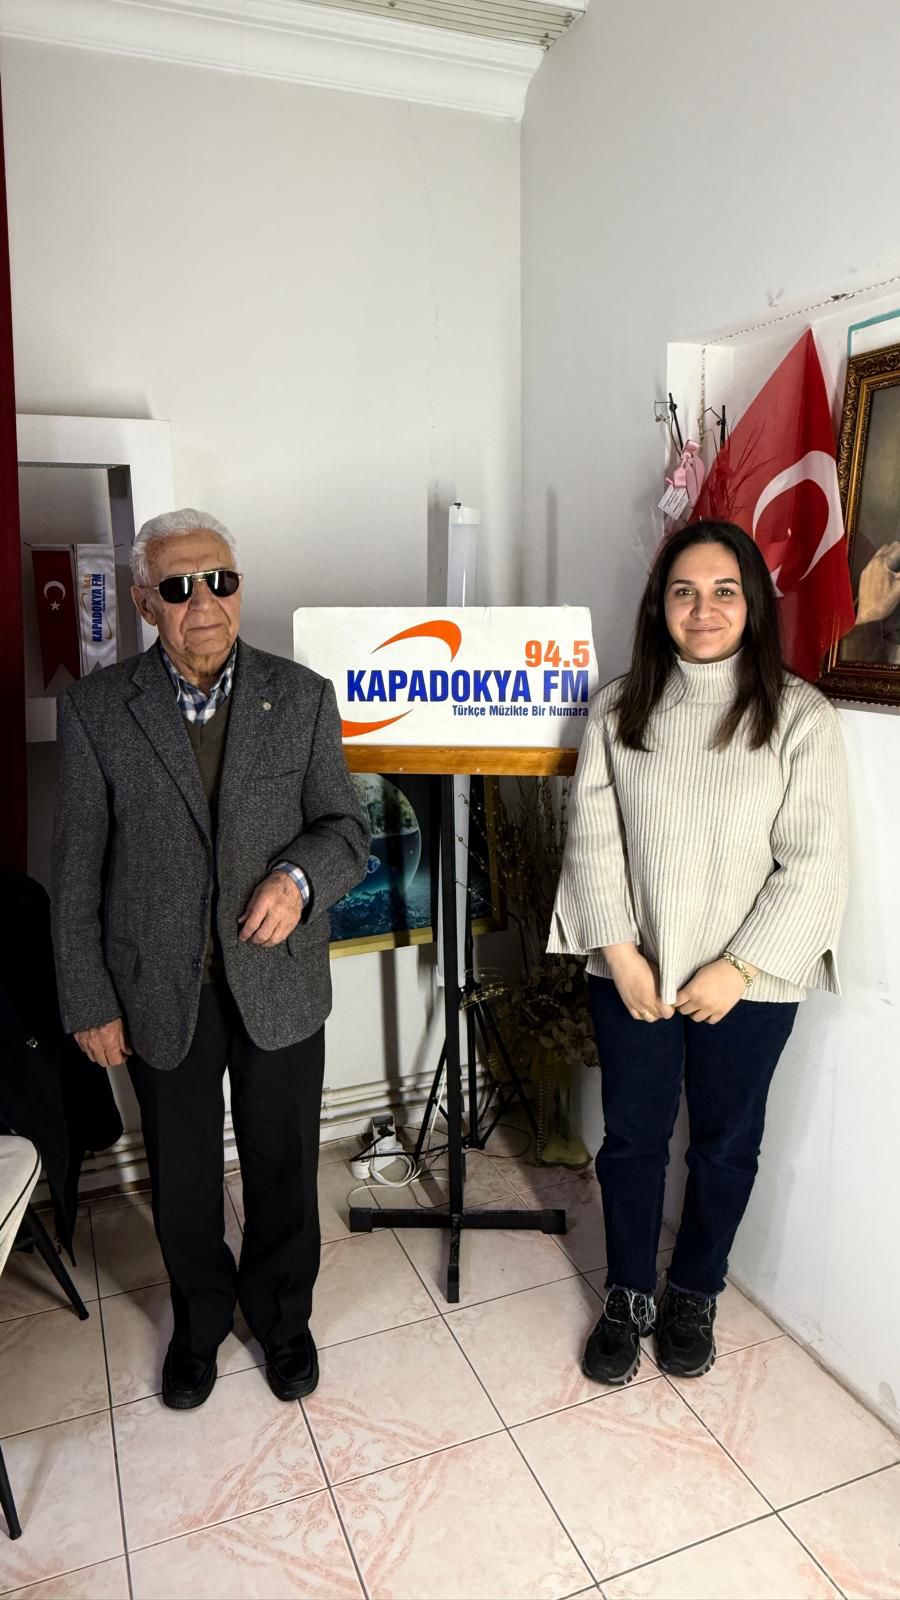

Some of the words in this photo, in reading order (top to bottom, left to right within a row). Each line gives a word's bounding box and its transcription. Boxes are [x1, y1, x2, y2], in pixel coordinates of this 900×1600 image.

[92, 573, 102, 586] FM
[92, 590, 103, 642] KAPADOKYA
[525, 640, 590, 667] 94.5
[347, 670, 531, 702] KAPADOKYA
[543, 670, 589, 702] FM
[452, 705, 486, 717] Türkçe
[489, 705, 529, 716] Müzikte
[532, 705, 546, 716] Bir
[549, 705, 588, 717] Numara
